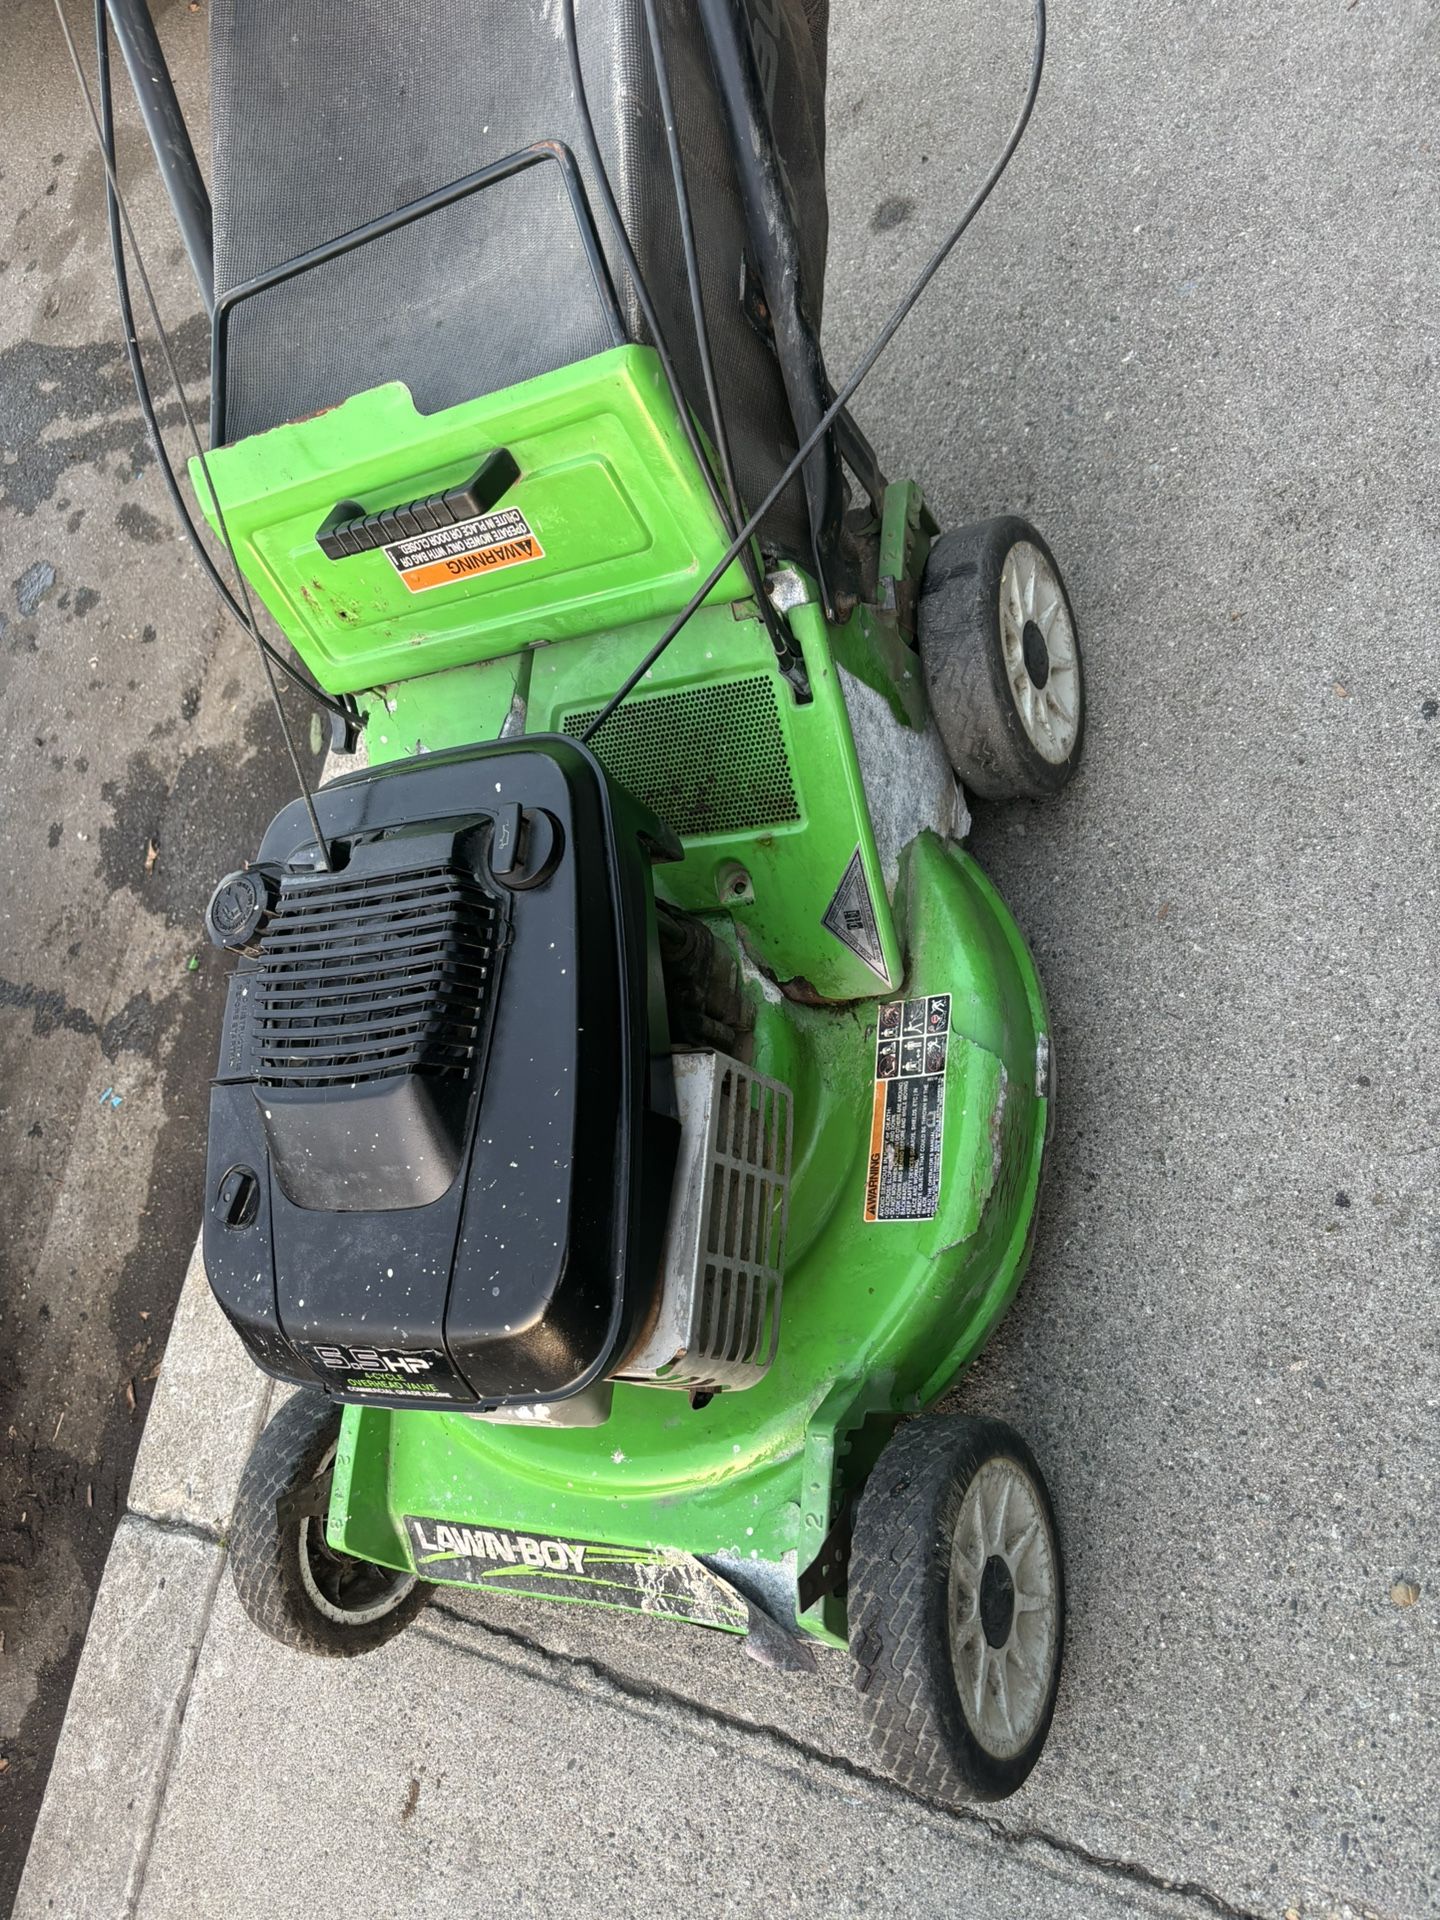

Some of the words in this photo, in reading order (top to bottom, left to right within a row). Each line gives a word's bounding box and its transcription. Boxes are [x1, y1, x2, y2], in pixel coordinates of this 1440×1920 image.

[483, 517, 496, 529] IN
[492, 509, 521, 526] CHUTE
[448, 527, 463, 539] OR
[459, 520, 487, 536] PLACE
[490, 521, 528, 541] OPERATE
[426, 530, 452, 546] DOOR
[462, 531, 494, 549] MOWER
[397, 537, 431, 555] CLOSED.
[425, 545, 449, 560] WITH
[444, 539, 466, 554] ONLY
[398, 555, 414, 567] OR
[409, 550, 430, 564] BAG
[444, 542, 521, 575] WARNING
[867, 1153, 880, 1204] WARNING
[365, 1372, 406, 1381] 4-CYCLE
[347, 1378, 403, 1389] OVERHEAD
[405, 1382, 439, 1391] VALVE
[806, 1513, 823, 1528] 2
[414, 1522, 588, 1574] LAWN-BOY
